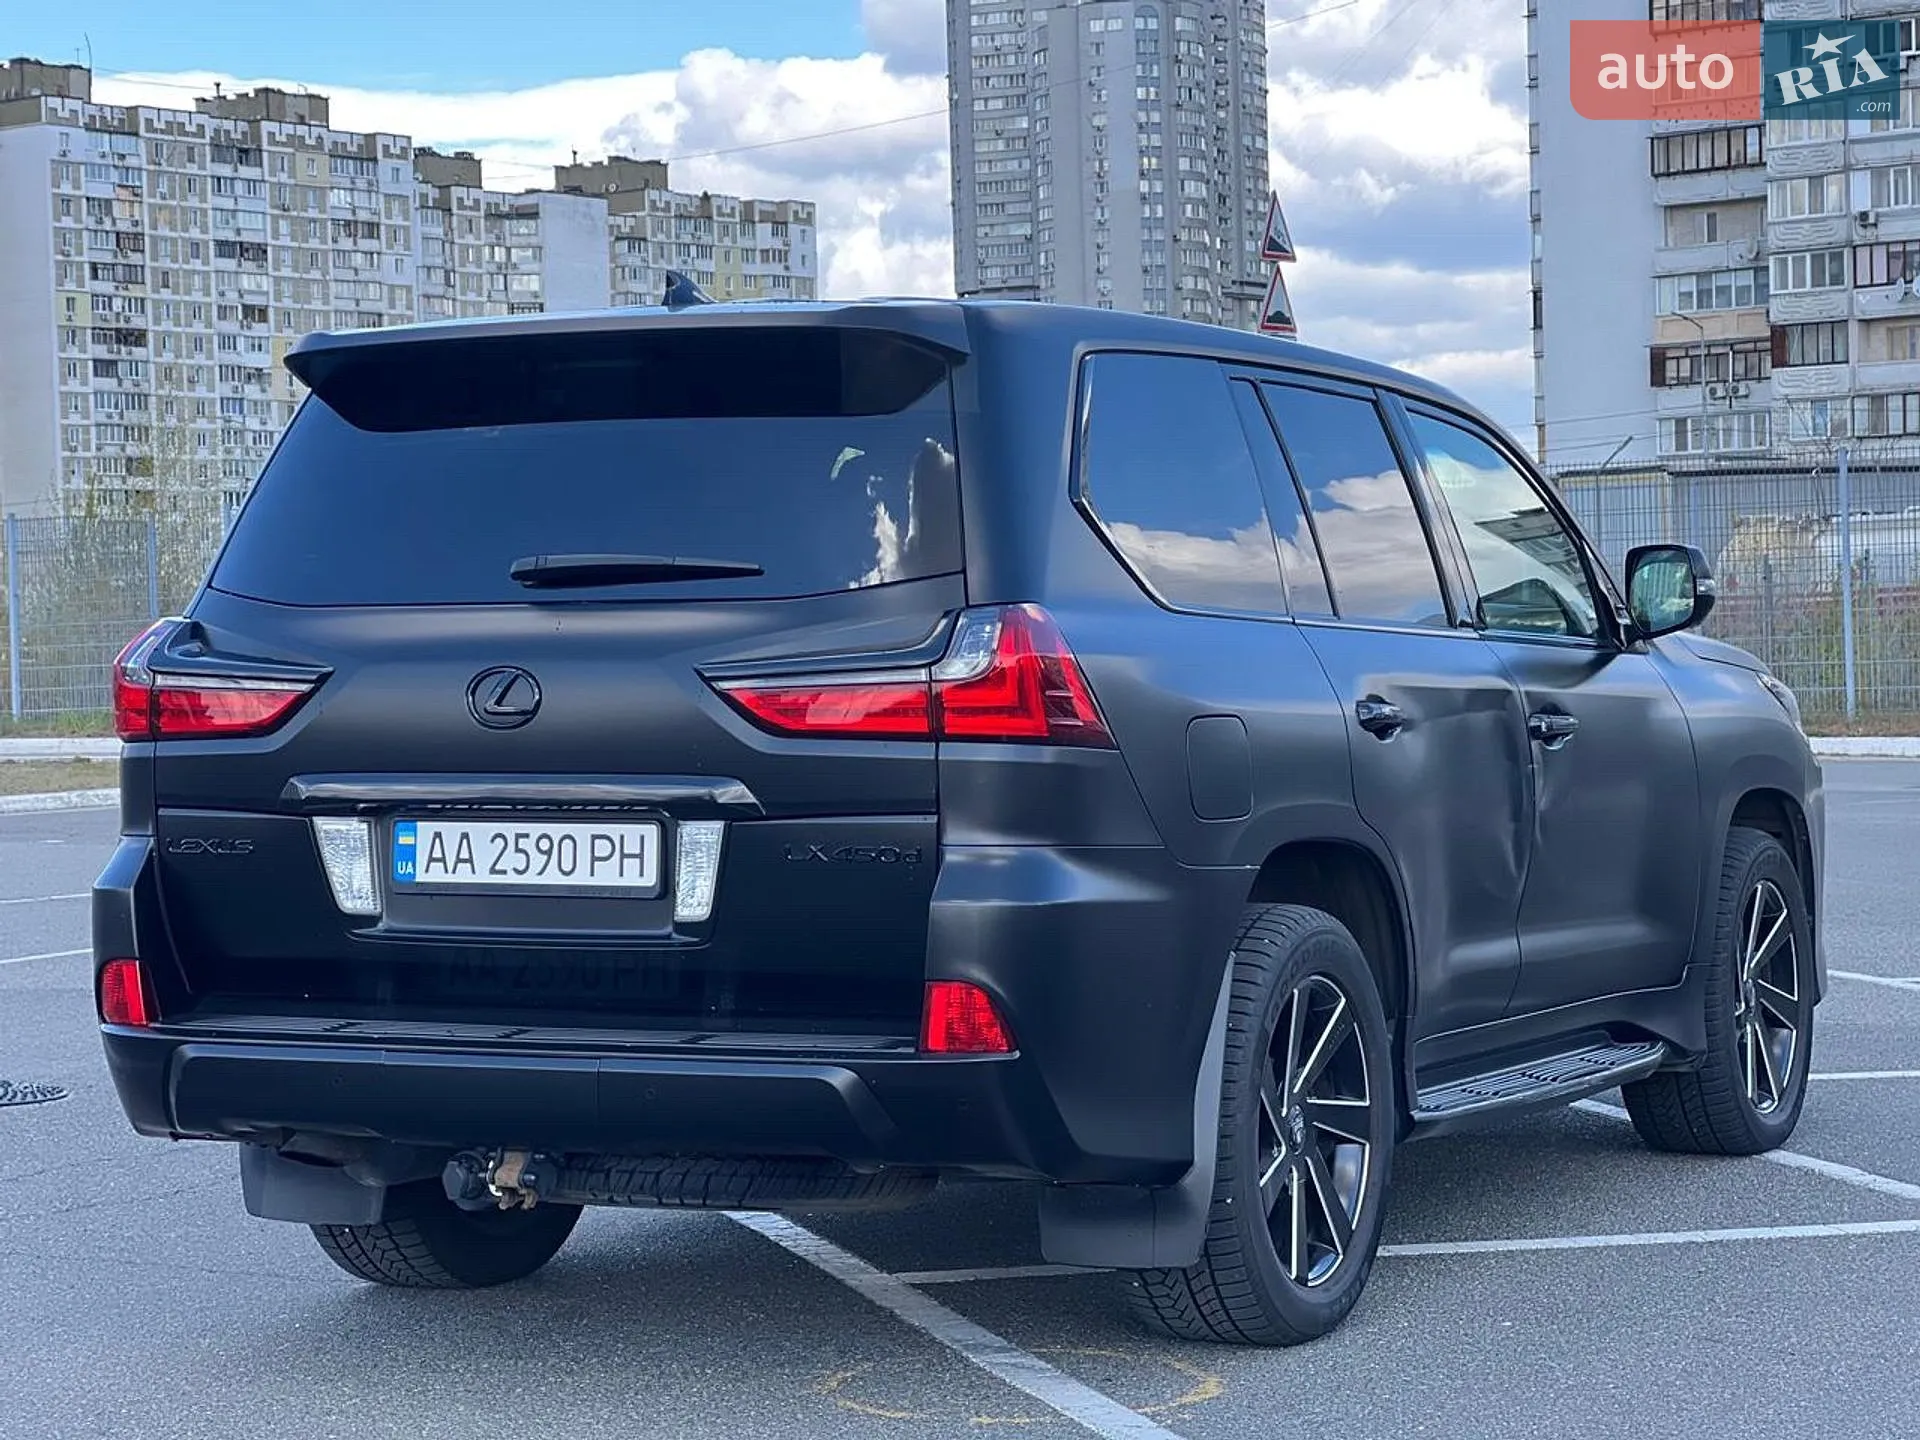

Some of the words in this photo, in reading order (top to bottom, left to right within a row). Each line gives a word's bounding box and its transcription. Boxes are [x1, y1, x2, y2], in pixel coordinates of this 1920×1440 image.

[166, 837, 255, 855] LEXUS
[425, 831, 476, 875] AA
[489, 832, 577, 876] 2590
[589, 834, 645, 877] PH
[783, 843, 922, 863] LX450d
[398, 862, 414, 875] UA
